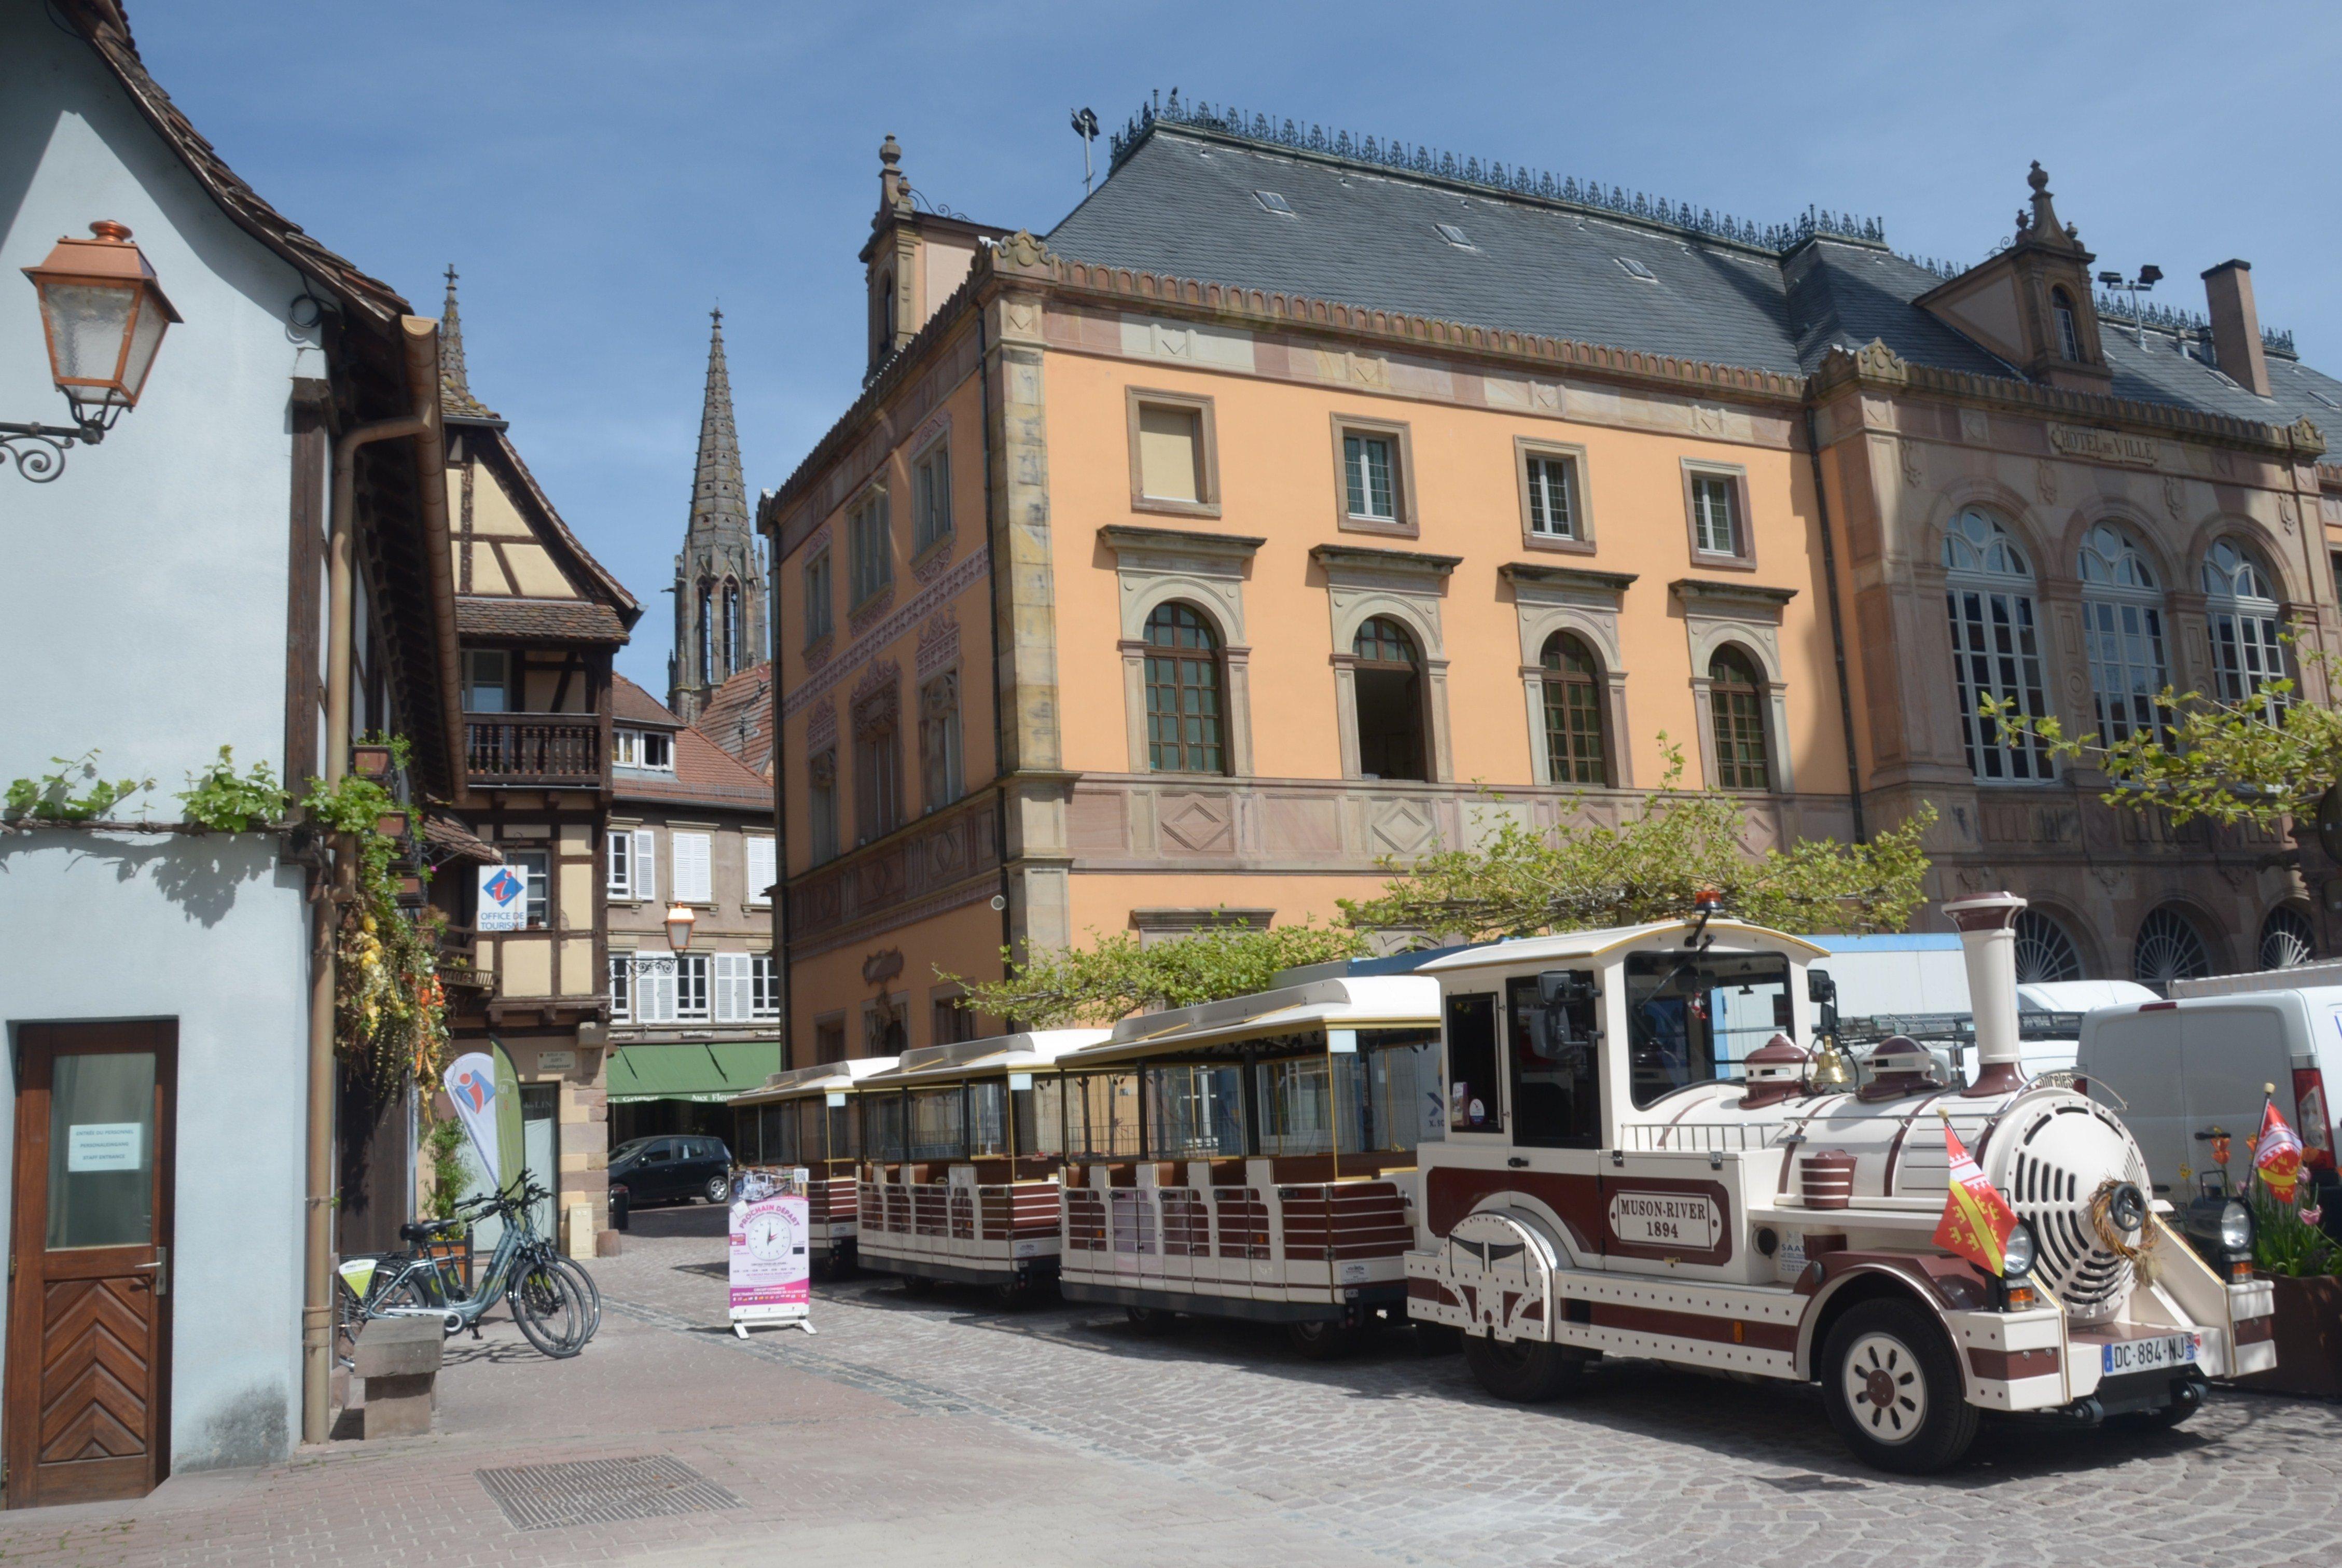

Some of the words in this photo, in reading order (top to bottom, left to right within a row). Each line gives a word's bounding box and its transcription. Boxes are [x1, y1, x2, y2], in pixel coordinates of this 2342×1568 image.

[2113, 438, 2153, 459] VILLE
[480, 912, 511, 920] OFFICE
[739, 1205, 774, 1228] PROCHAIN
[776, 1206, 800, 1226] DÉPART
[1646, 1221, 1679, 1238] 1894
[2114, 1337, 2184, 1368] DC-884-NJ
